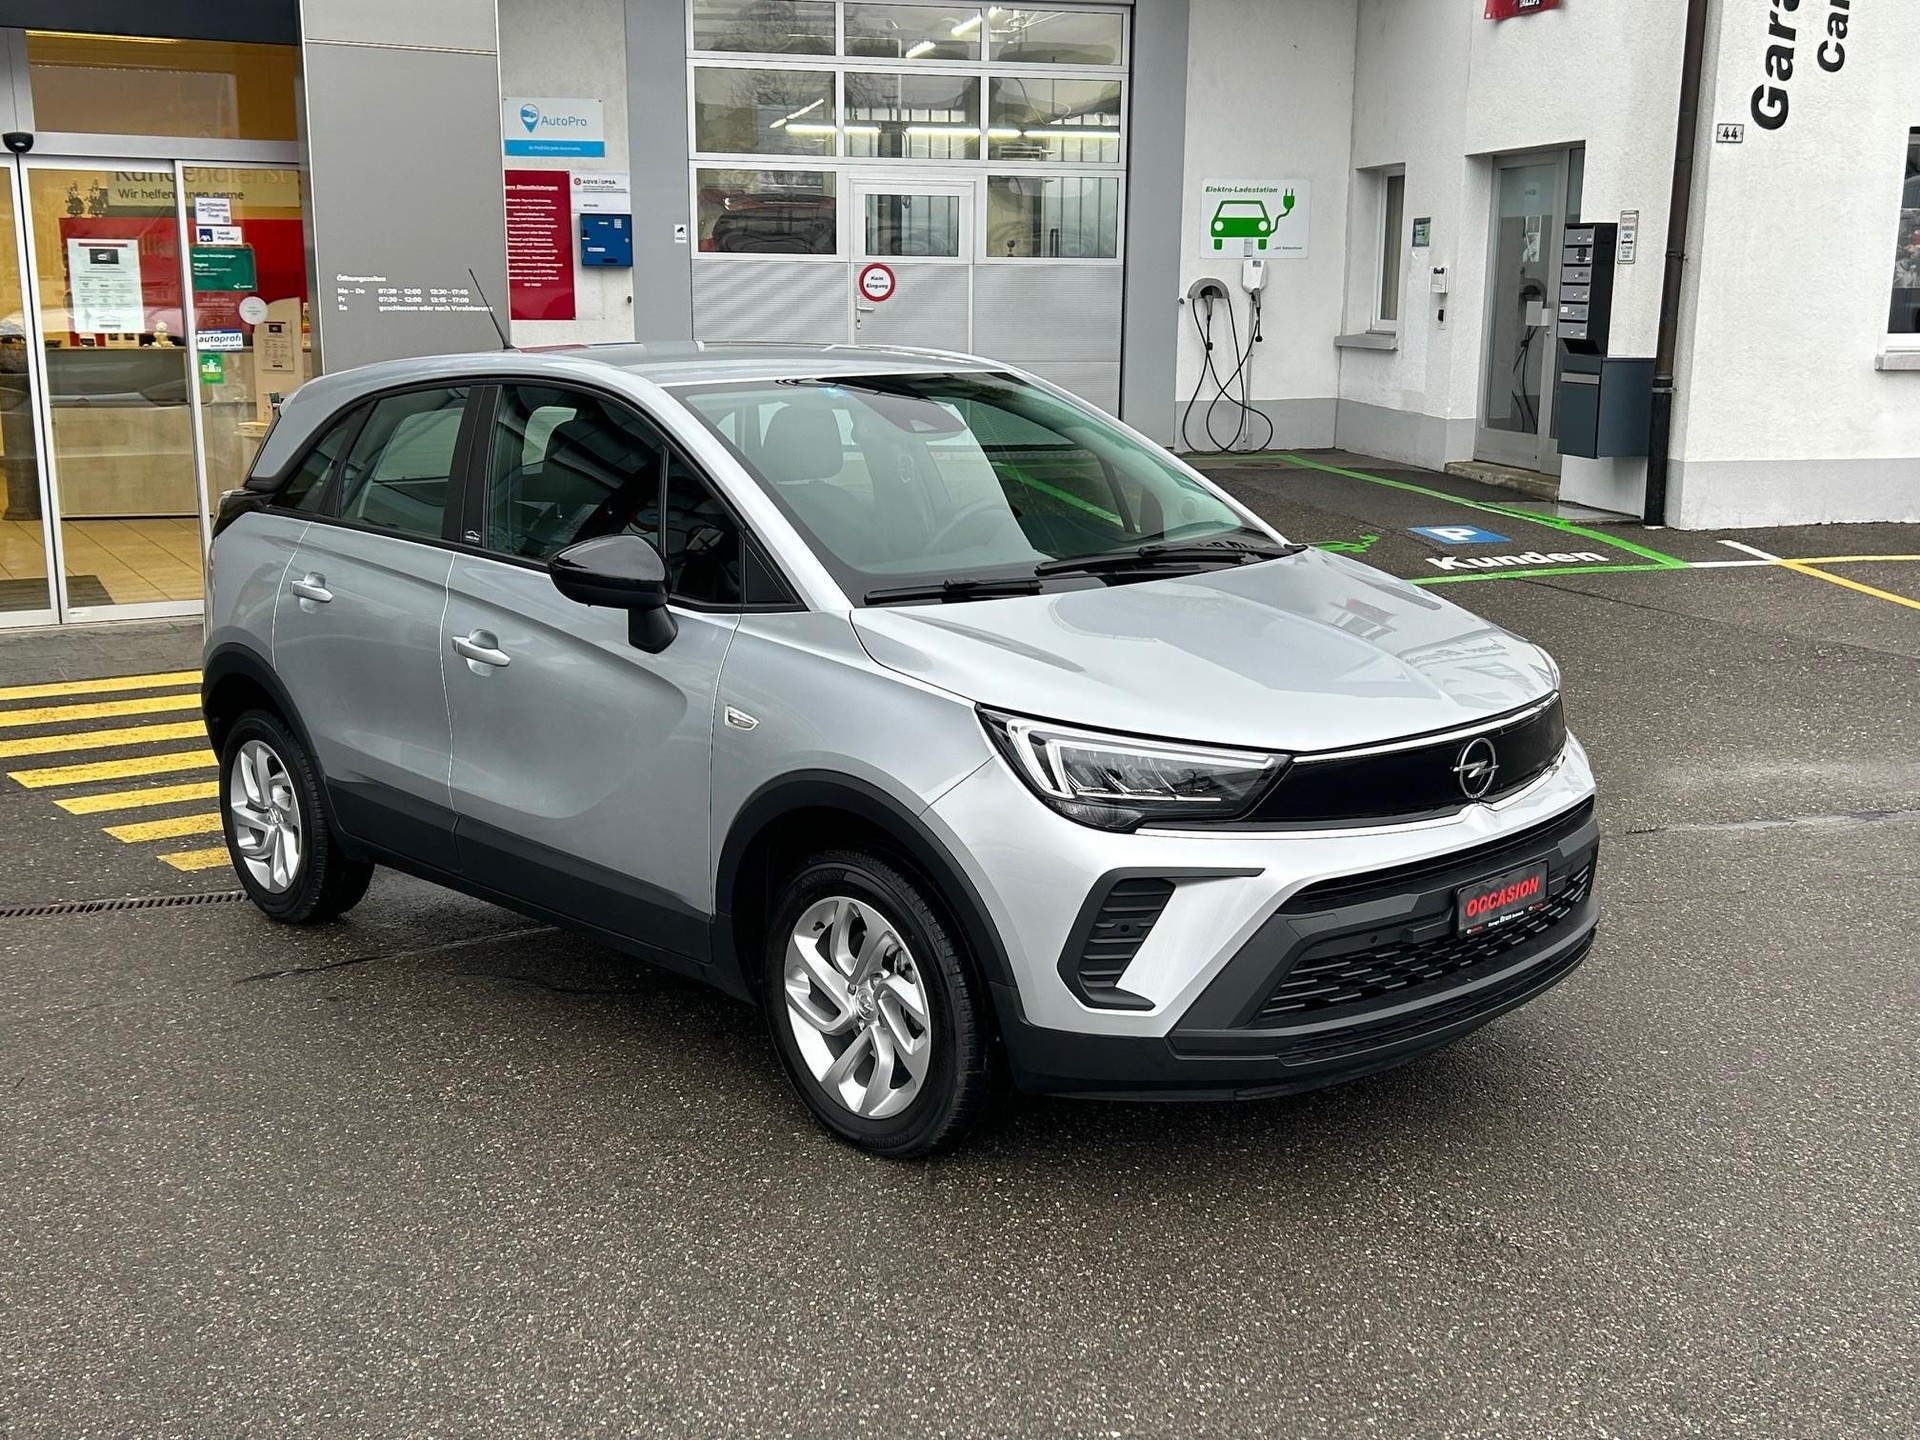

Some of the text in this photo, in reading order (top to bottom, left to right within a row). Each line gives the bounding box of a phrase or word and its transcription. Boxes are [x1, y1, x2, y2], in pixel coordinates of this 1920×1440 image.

[541, 115, 587, 126] AutoPro
[1722, 127, 1738, 140] 44
[118, 188, 138, 198] Wir
[142, 187, 175, 199] helfen
[1205, 185, 1278, 193] Elektro-Ladestation
[336, 274, 387, 283] Öffnungszeiten
[198, 334, 241, 343] autoprofi
[1427, 528, 1477, 541] P
[1425, 551, 1609, 570] Kunden
[1466, 876, 1539, 917] OCCASION
